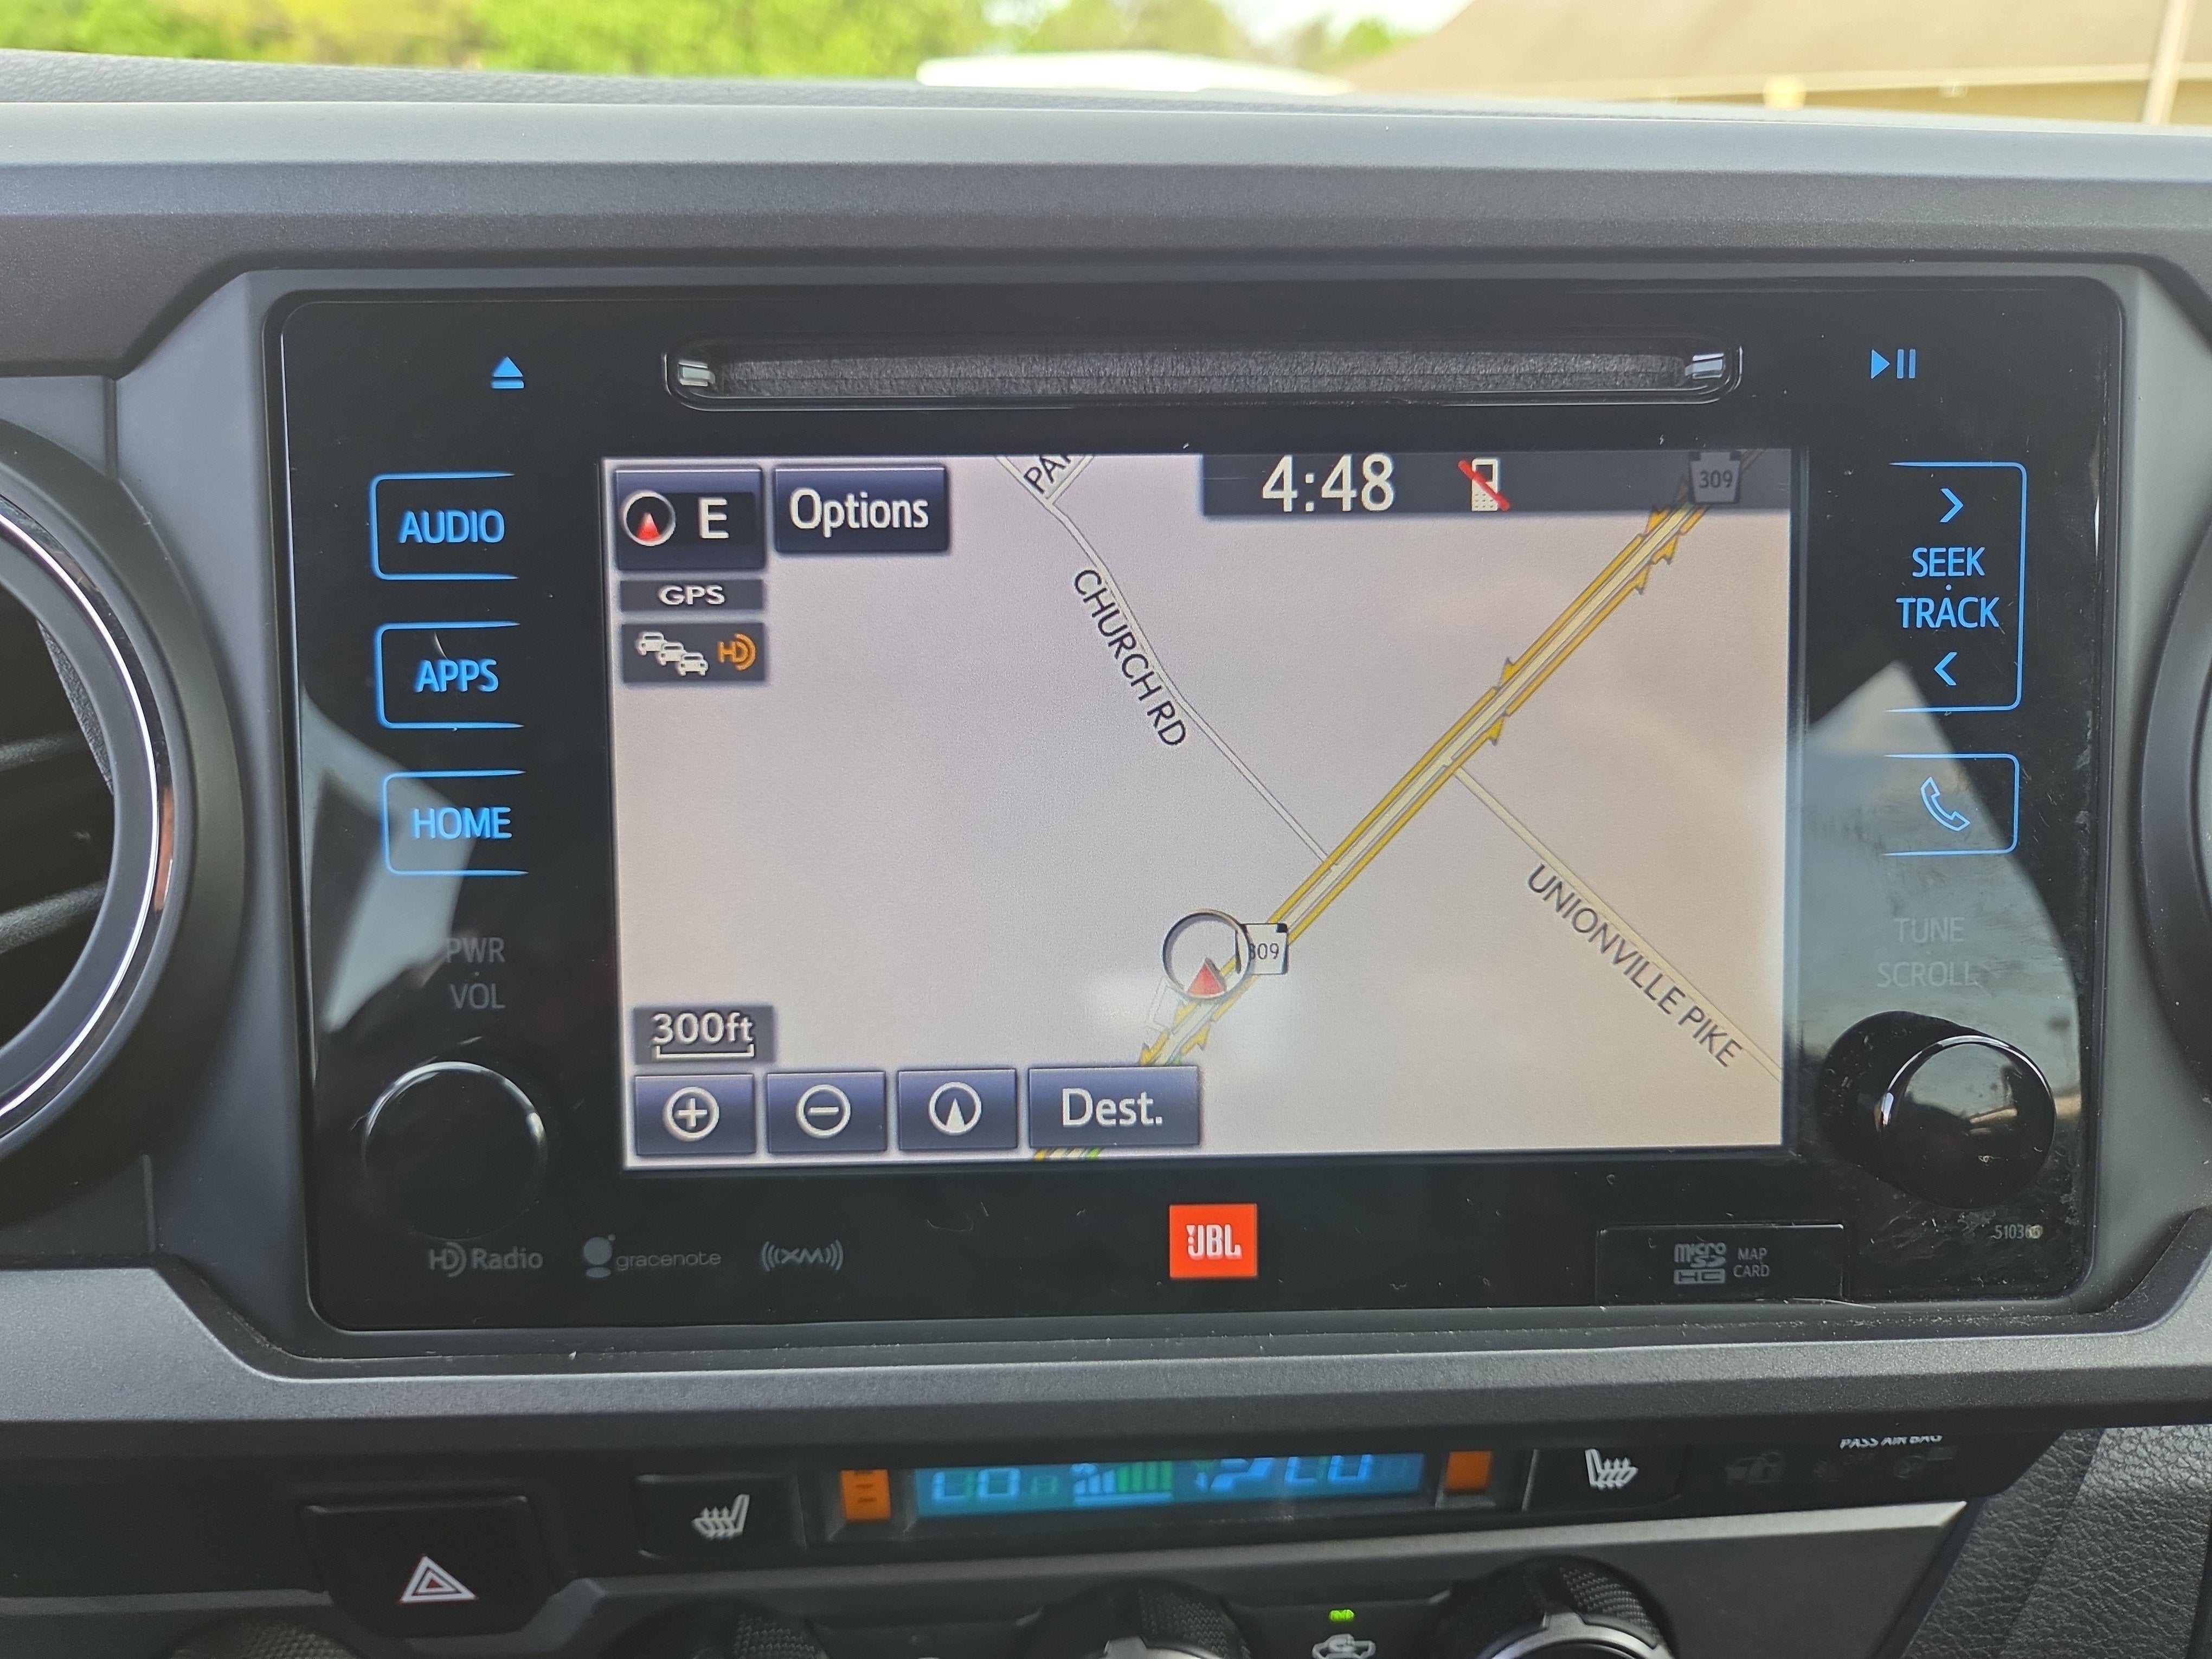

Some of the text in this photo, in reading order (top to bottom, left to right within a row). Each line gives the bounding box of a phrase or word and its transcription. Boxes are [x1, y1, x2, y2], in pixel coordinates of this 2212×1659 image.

[1262, 453, 1395, 513] 4:48
[1699, 470, 1733, 488] 309
[399, 509, 505, 544] AUDIO
[698, 497, 730, 539] E
[790, 487, 929, 538] Options
[1912, 546, 1986, 577] SEEK
[658, 584, 725, 605] GPS
[1896, 596, 1999, 628] TRACK
[1073, 569, 1186, 747] CHURCH RD
[414, 659, 499, 693] APPS
[413, 807, 512, 839] HOME
[1894, 917, 1965, 943] TUNE
[446, 937, 505, 963] PWR
[1527, 864, 1742, 1067] UNIONVILLE PIKE
[1876, 961, 1978, 987] SCROLL
[450, 983, 505, 1009] VOL
[652, 1012, 754, 1045] 300ft
[1061, 1088, 1162, 1129] Dest.
[1186, 1224, 1242, 1259] JBL
[1738, 1248, 1767, 1260] MAP
[428, 1244, 543, 1274] HD Radio
[616, 1249, 722, 1272] gracenote
[1733, 1264, 1770, 1278] CARD
